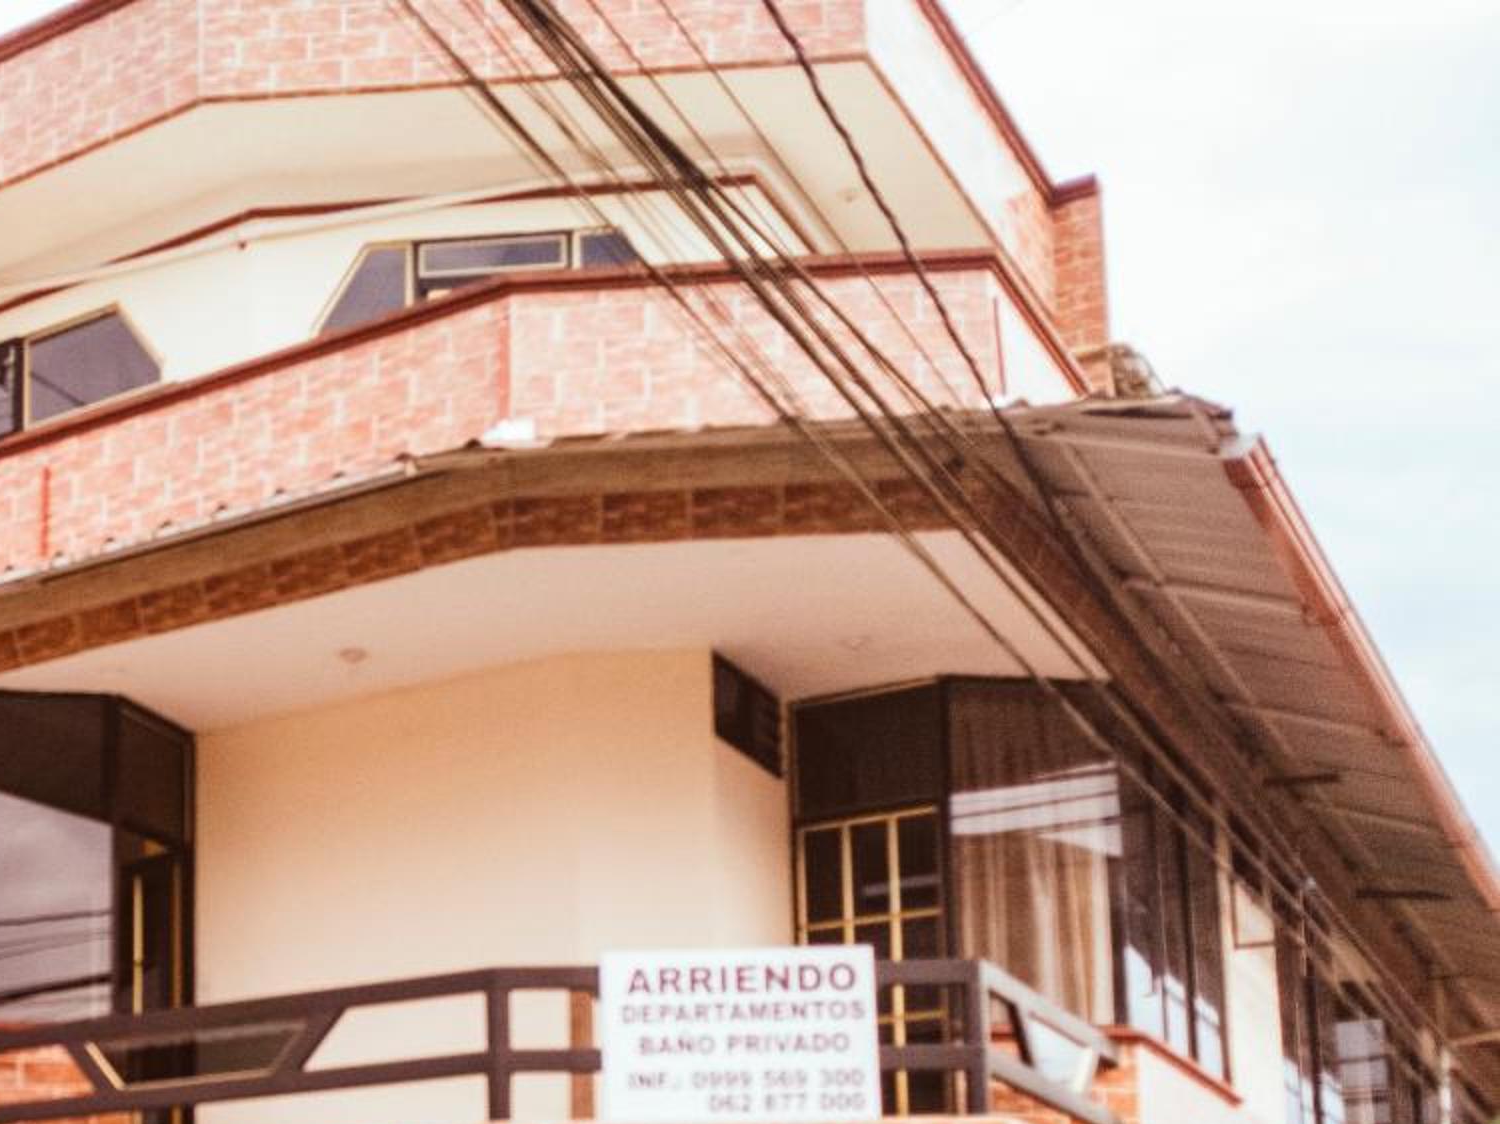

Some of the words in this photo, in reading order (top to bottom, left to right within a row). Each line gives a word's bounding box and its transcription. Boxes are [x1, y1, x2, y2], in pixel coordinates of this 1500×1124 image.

[627, 963, 857, 994] ARRIENDO
[621, 1000, 866, 1024] DEPARTAMENTOS
[727, 1033, 851, 1055] PRIVADO
